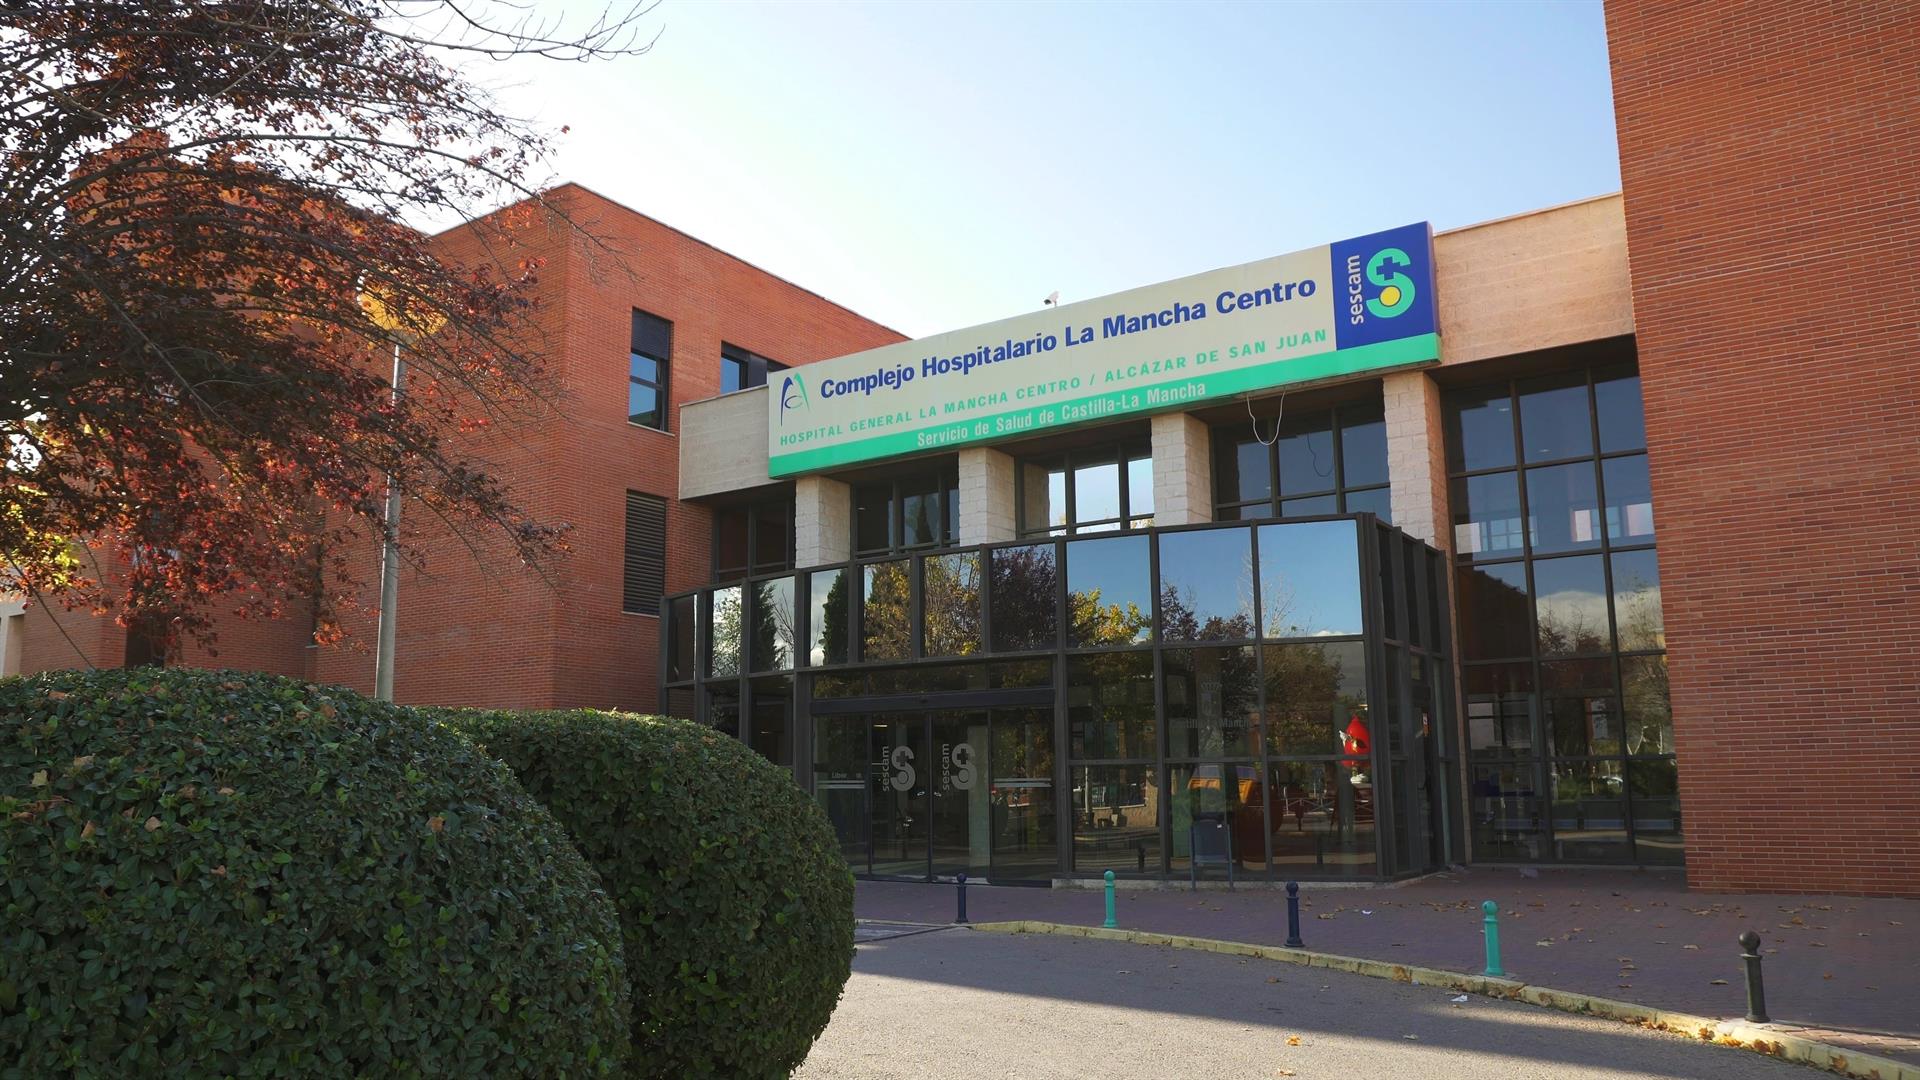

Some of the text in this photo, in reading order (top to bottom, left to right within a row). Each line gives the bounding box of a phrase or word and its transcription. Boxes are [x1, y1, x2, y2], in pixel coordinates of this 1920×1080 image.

[1346, 254, 1364, 325] sescam
[820, 279, 1316, 399] Complejo Hospitalario La Mancha Centro
[780, 329, 1327, 446] HOSPITAL GENERAL LA MANCHA CENTRO / ALCÁZAR DE SAN JUAN
[917, 381, 1206, 447] Servicio de Salud de Castilla-La Mancha
[882, 745, 890, 792] sescam
[942, 743, 950, 791] sescam
